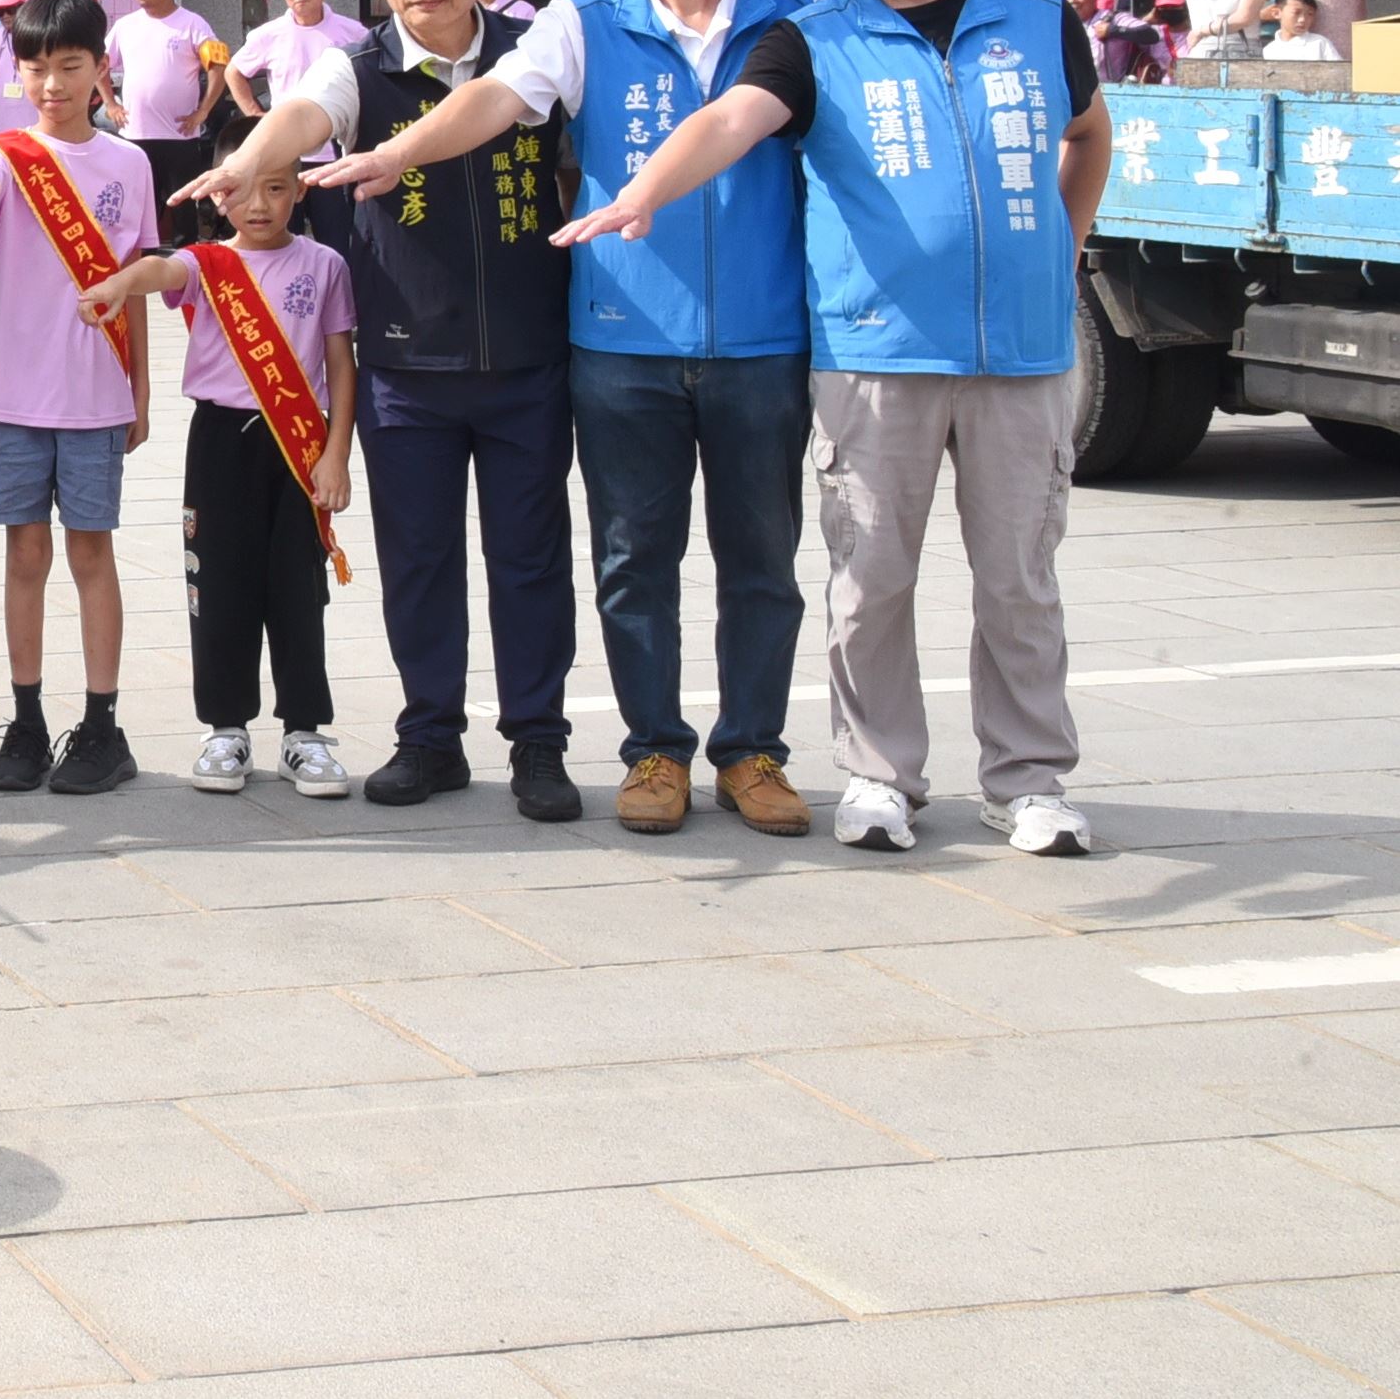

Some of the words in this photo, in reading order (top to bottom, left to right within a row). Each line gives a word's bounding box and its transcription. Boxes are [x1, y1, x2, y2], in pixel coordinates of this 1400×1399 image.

[625, 83, 651, 175] 巫志偉
[656, 72, 675, 132] 副處長
[862, 78, 912, 178] 陳漢清
[983, 71, 1035, 194] 邱鎮軍
[1022, 68, 1049, 154] 立法委員
[28, 163, 110, 282] 永貞宮四月八
[492, 152, 518, 244] 服務團隊
[513, 123, 541, 234] 鍾東錦
[217, 279, 300, 407] 永貞宮四月八
